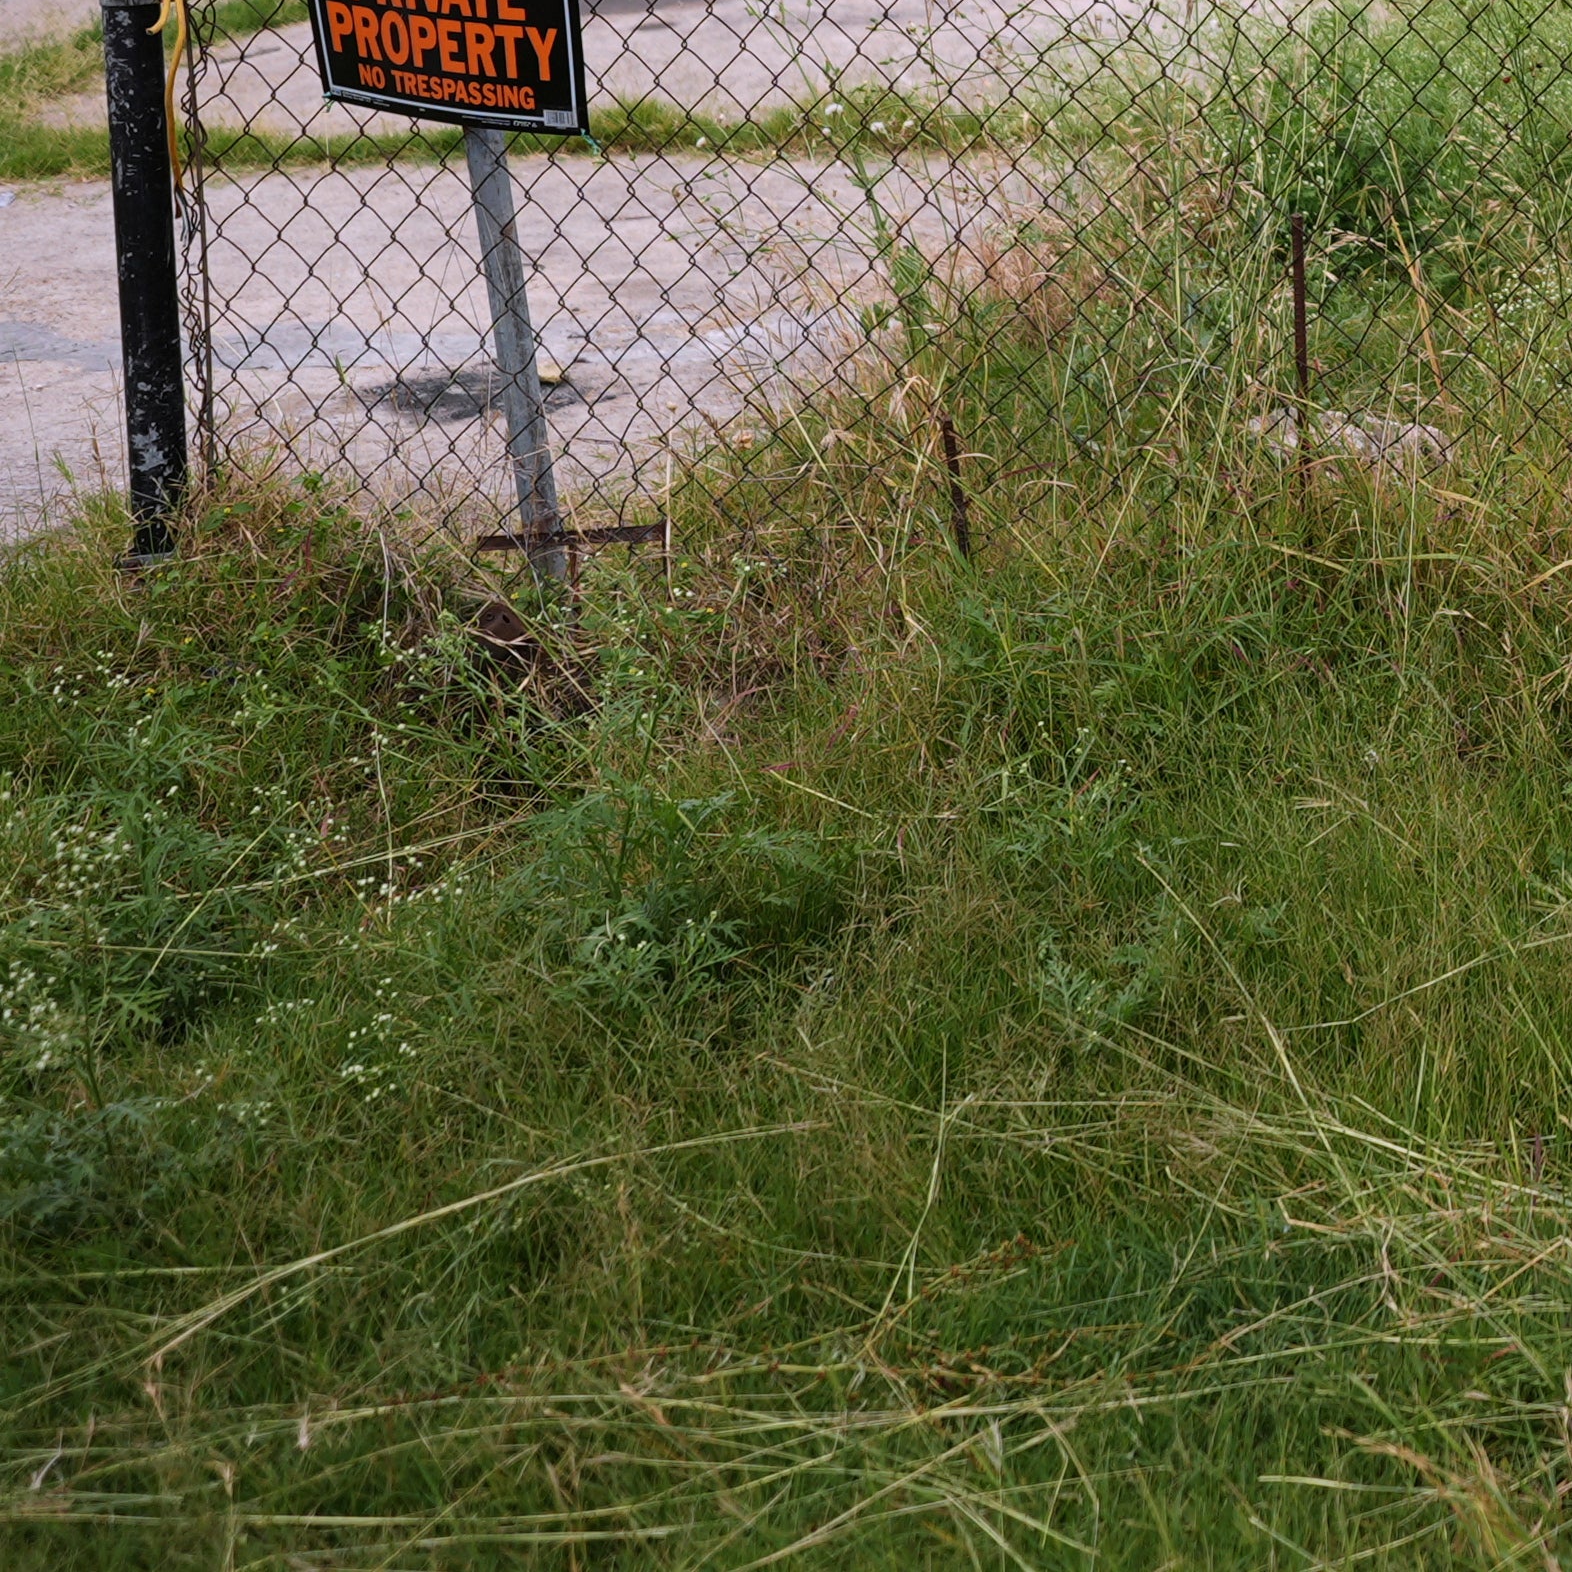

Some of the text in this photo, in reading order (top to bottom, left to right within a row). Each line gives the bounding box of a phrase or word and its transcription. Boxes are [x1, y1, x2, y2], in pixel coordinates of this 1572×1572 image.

[325, 0, 558, 81] PROPERTY
[357, 63, 386, 89] NO
[391, 69, 536, 110] TRESPASSING
